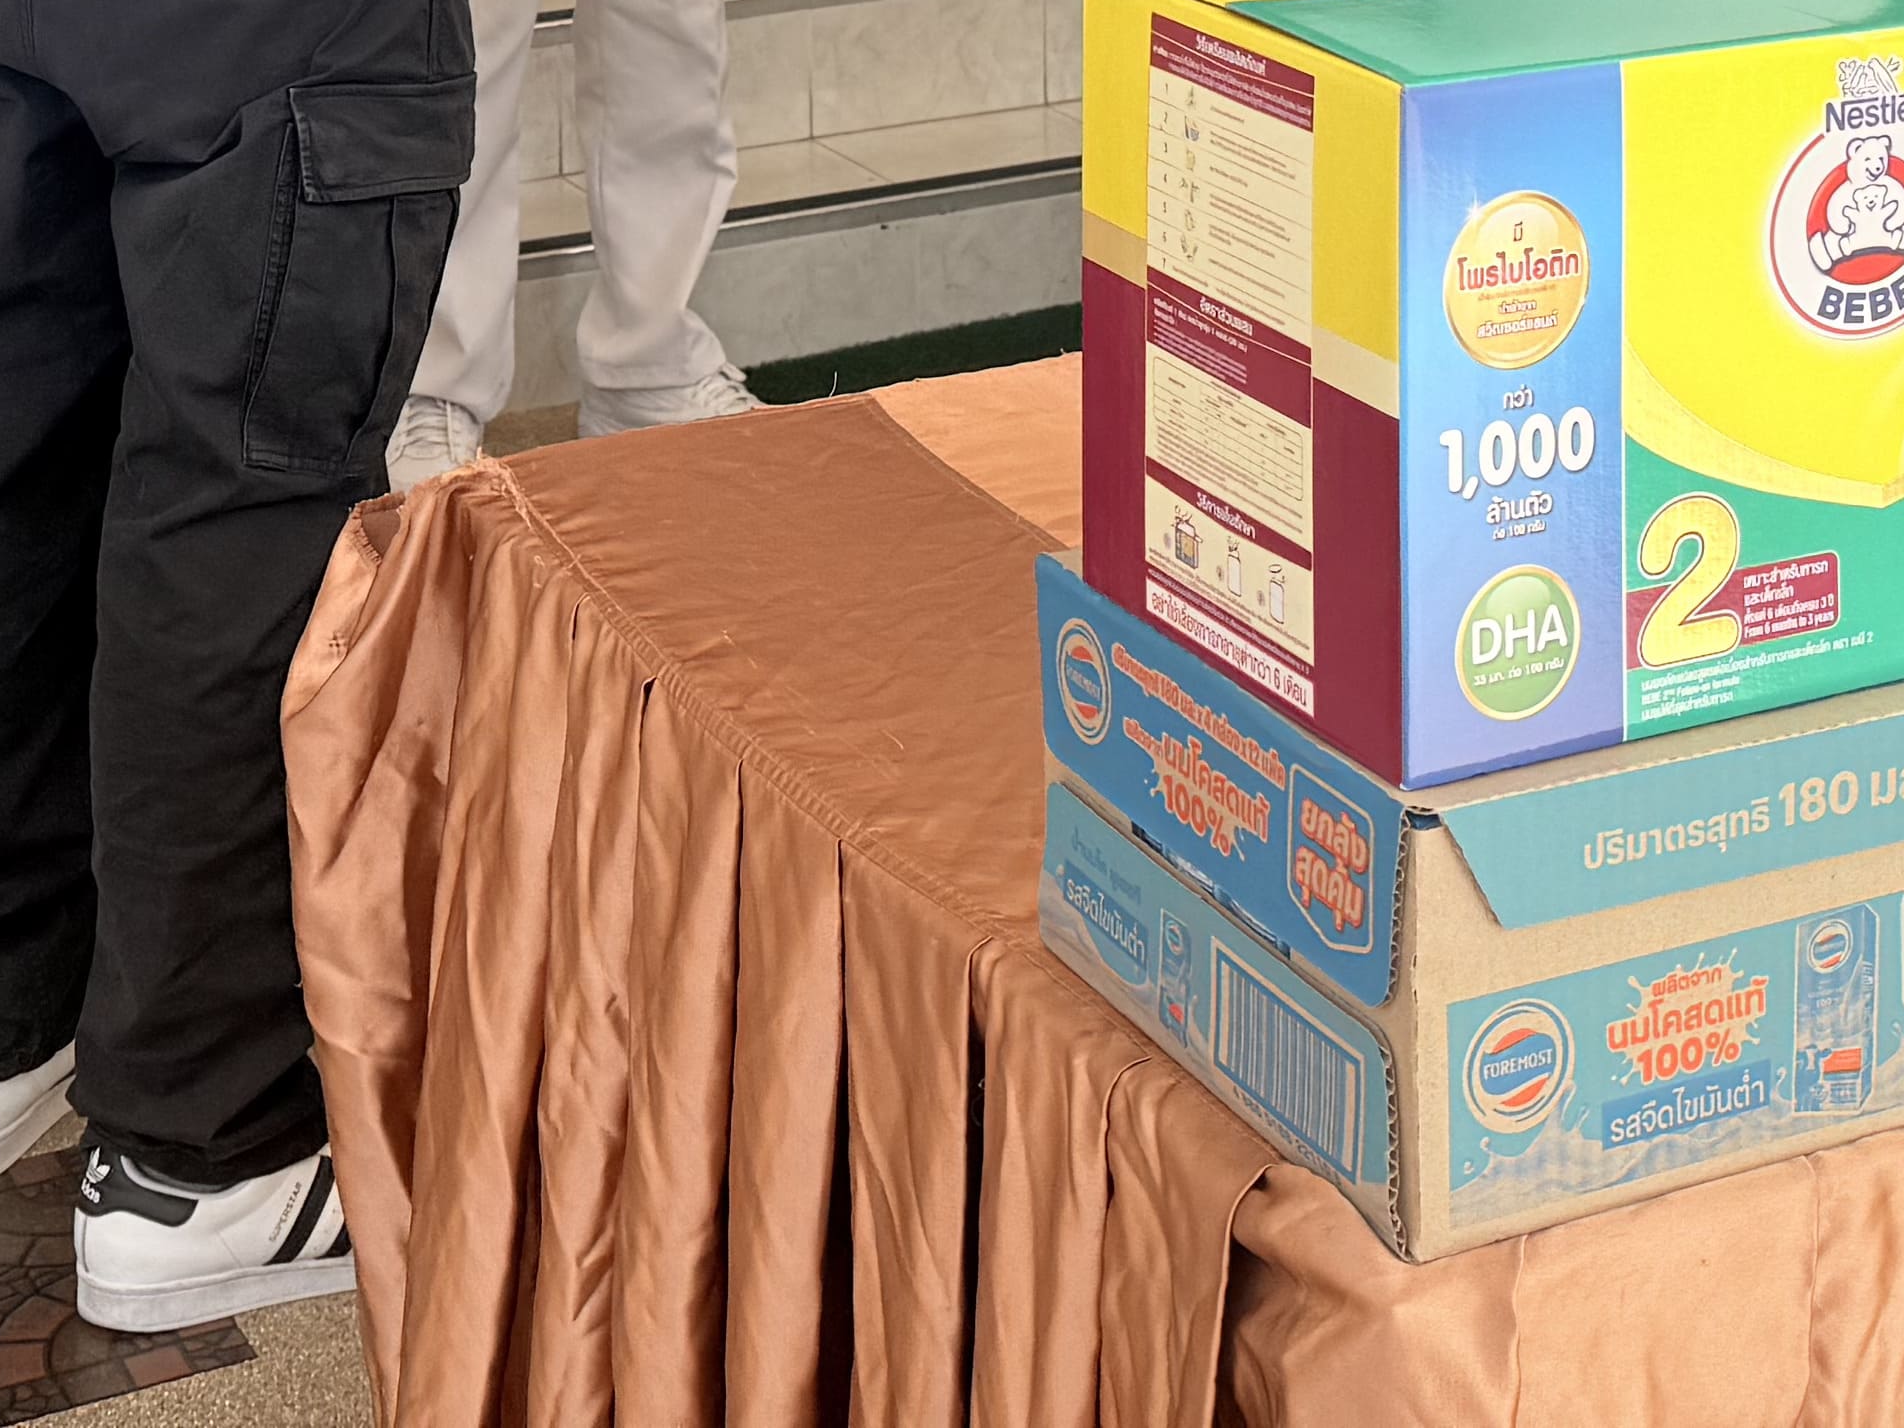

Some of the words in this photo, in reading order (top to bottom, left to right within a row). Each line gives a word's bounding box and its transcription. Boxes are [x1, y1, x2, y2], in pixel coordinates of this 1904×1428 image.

[1512, 220, 1524, 242] มี
[1456, 246, 1580, 292] โพรไบโอติก
[1503, 383, 1535, 411] กว่า
[1439, 405, 1597, 501] 1,000
[1486, 491, 1555, 526] ล้านตัว
[1637, 490, 1743, 671] 2
[1471, 603, 1569, 666] DHA
[1283, 676, 1308, 709] เดือน
[1160, 731, 1271, 844] นมโคสดแท้
[1261, 747, 1287, 793] แพ็ค
[1163, 774, 1232, 858] 100%
[1300, 795, 1369, 875] ยกลัง
[1582, 794, 1771, 872] ปริมาตรสุทธิ
[1777, 770, 1860, 829] 180
[1065, 877, 1147, 967] รสจืดไขมันต่ำ
[1294, 844, 1367, 933] สุดคุ้ม
[1605, 975, 1770, 1053] นมโคสดแท้
[1650, 964, 1724, 999] ผลิตจาก
[1481, 1045, 1555, 1082] FOREMOST
[1635, 1024, 1742, 1086] 100%
[1609, 1067, 1767, 1146] รสจืดไขมันต่ำ
